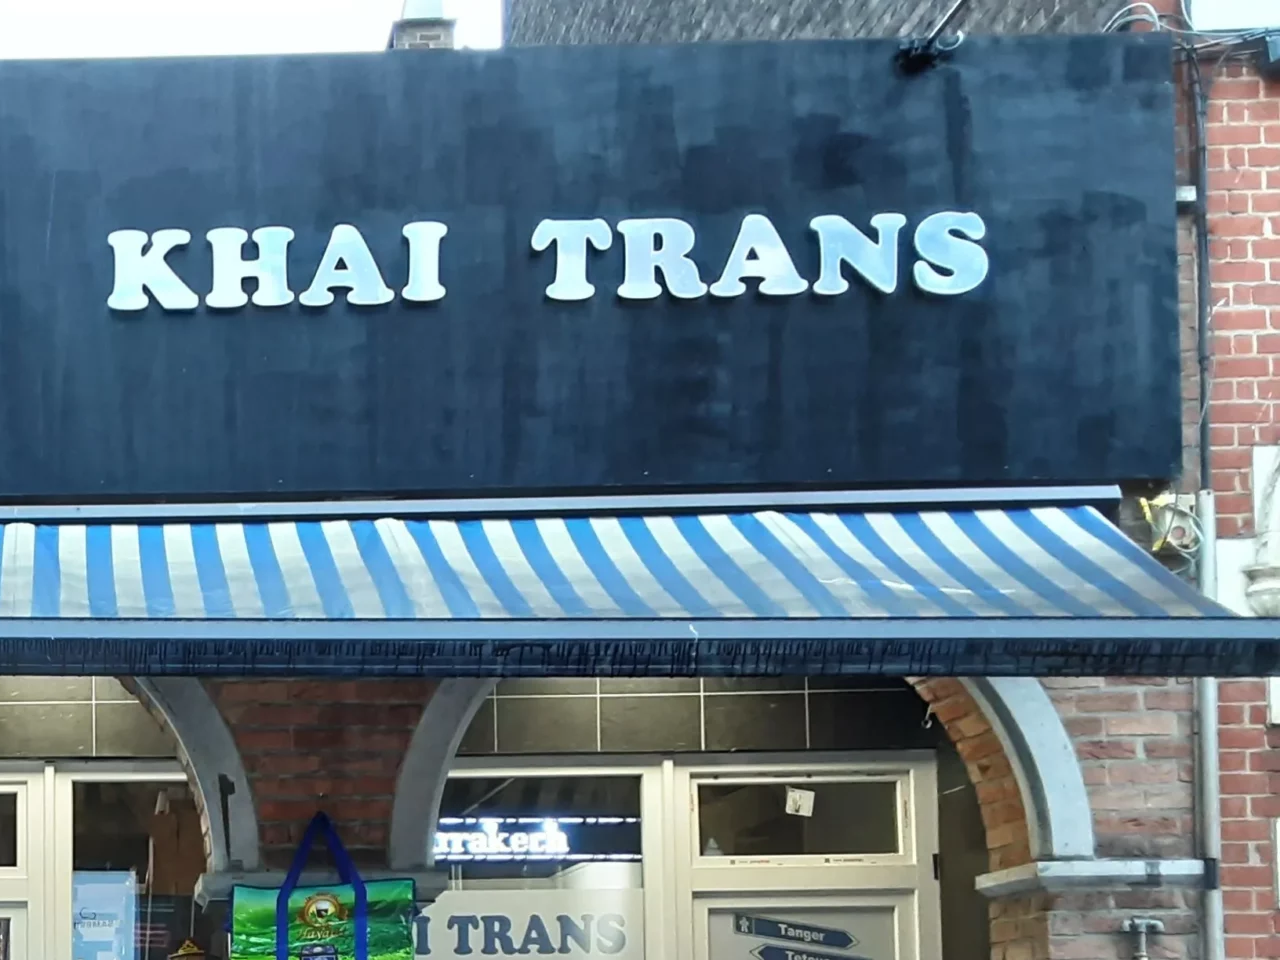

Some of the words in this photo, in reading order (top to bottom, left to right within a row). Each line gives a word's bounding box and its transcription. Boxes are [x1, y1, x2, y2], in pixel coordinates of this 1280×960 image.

[106, 220, 449, 311] KHAI
[530, 211, 990, 300] TRANS
[447, 914, 627, 955] TRANS
[778, 923, 826, 942] Tanger
